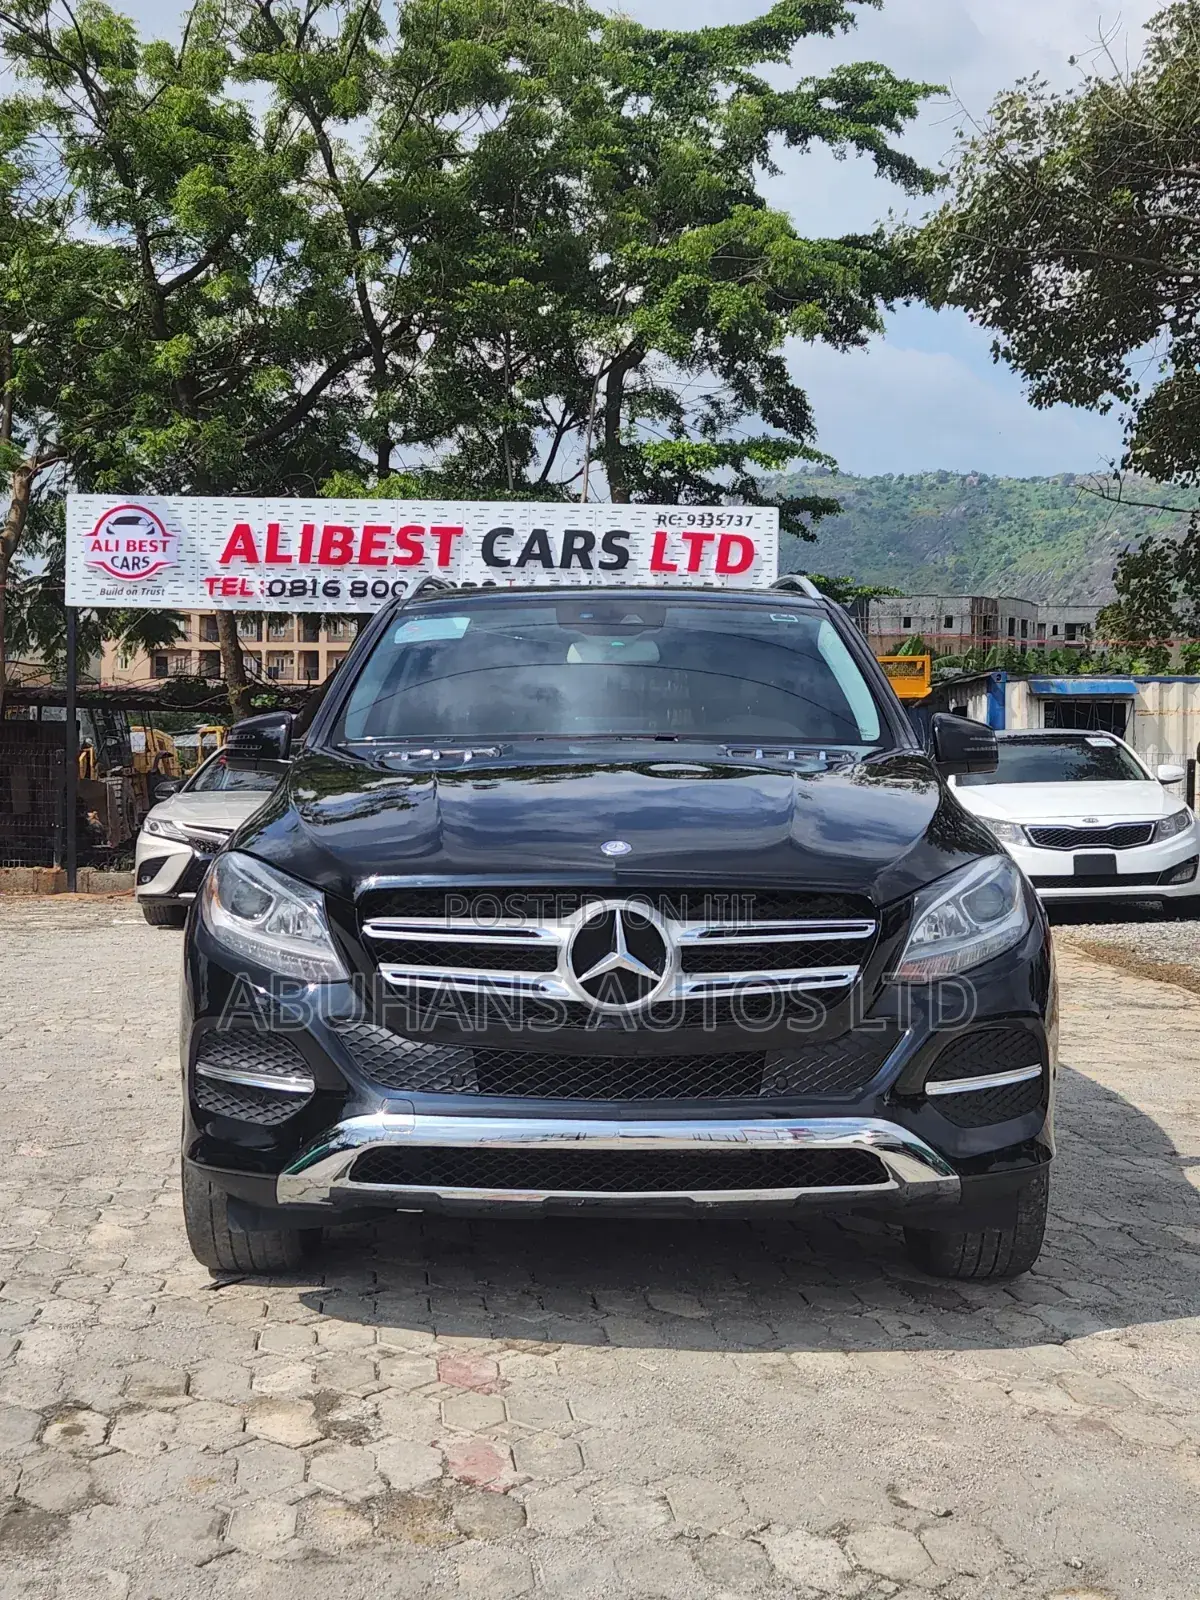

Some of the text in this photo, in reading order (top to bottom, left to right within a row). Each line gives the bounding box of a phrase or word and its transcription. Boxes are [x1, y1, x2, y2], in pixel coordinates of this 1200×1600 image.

[657, 513, 754, 528] RC: 9335737
[90, 539, 171, 553] ALI BEST
[218, 522, 756, 575] ALIBEST CARS LTD
[110, 555, 151, 571] CARS
[99, 587, 166, 596] Build on Trust
